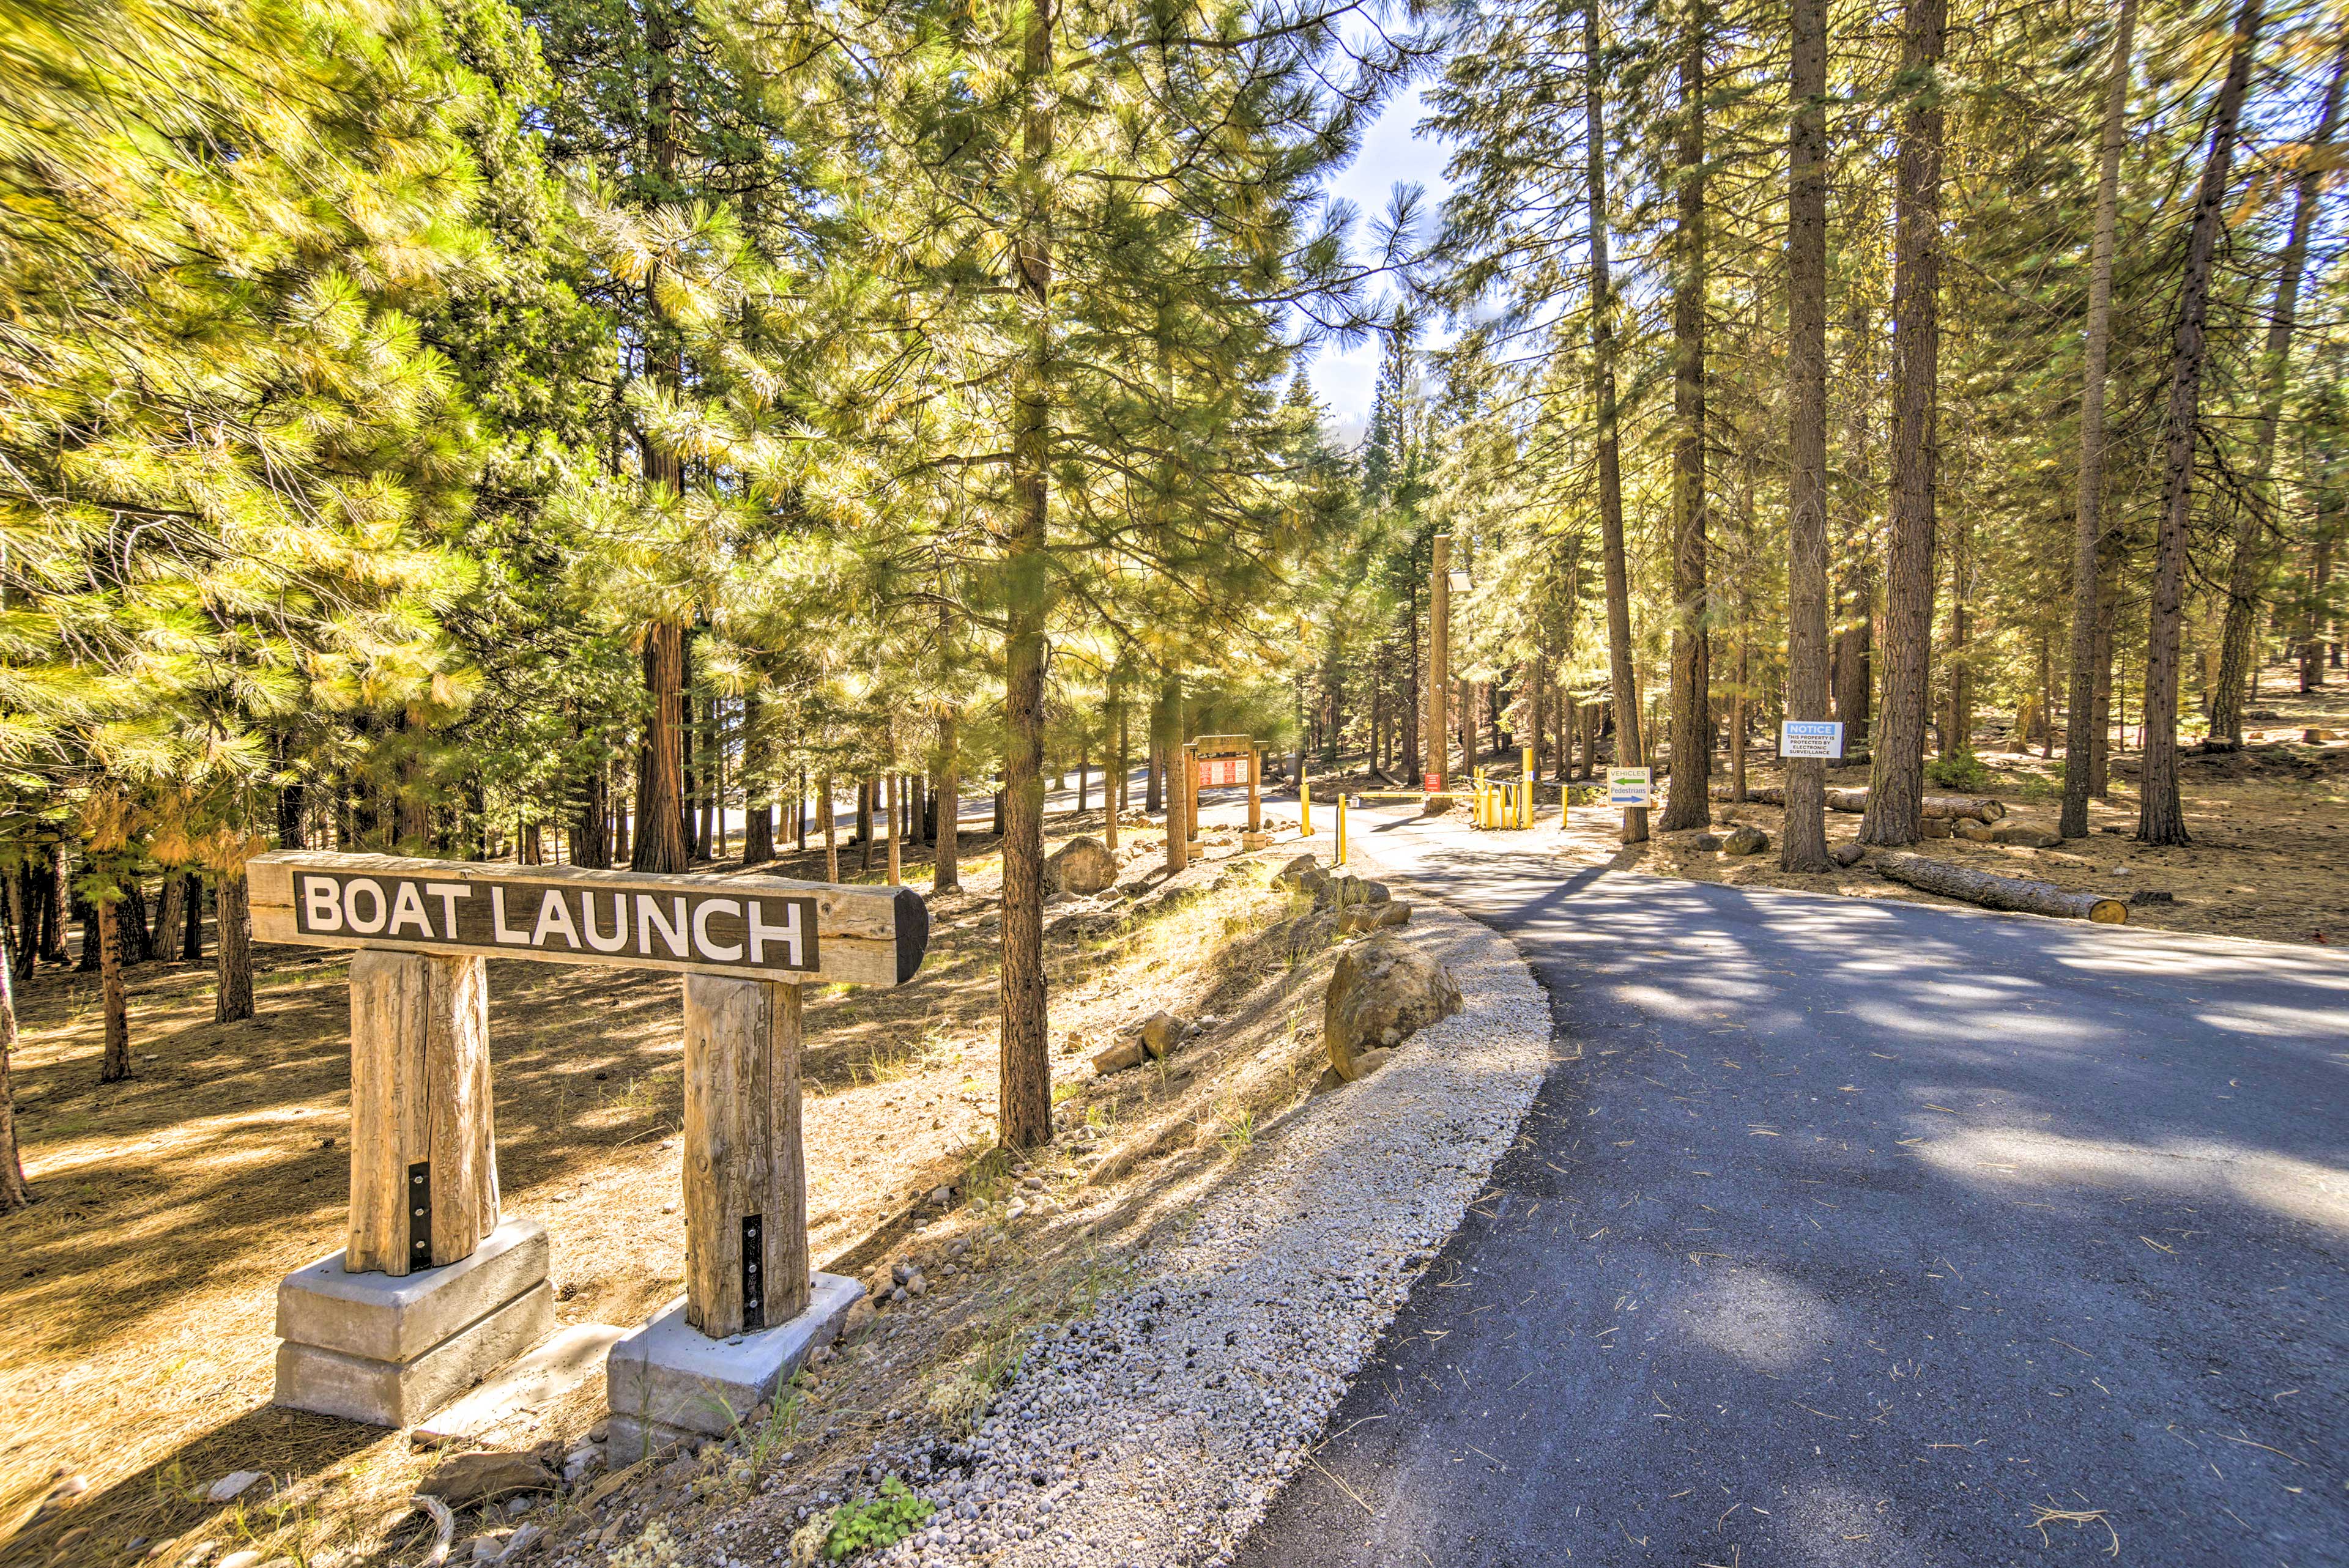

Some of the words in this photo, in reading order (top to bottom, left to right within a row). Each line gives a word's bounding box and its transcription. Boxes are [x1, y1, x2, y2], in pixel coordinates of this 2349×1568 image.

[1790, 725, 1832, 734] NOTICE
[304, 876, 471, 939] BOAT
[492, 886, 803, 966] LAUNCH
